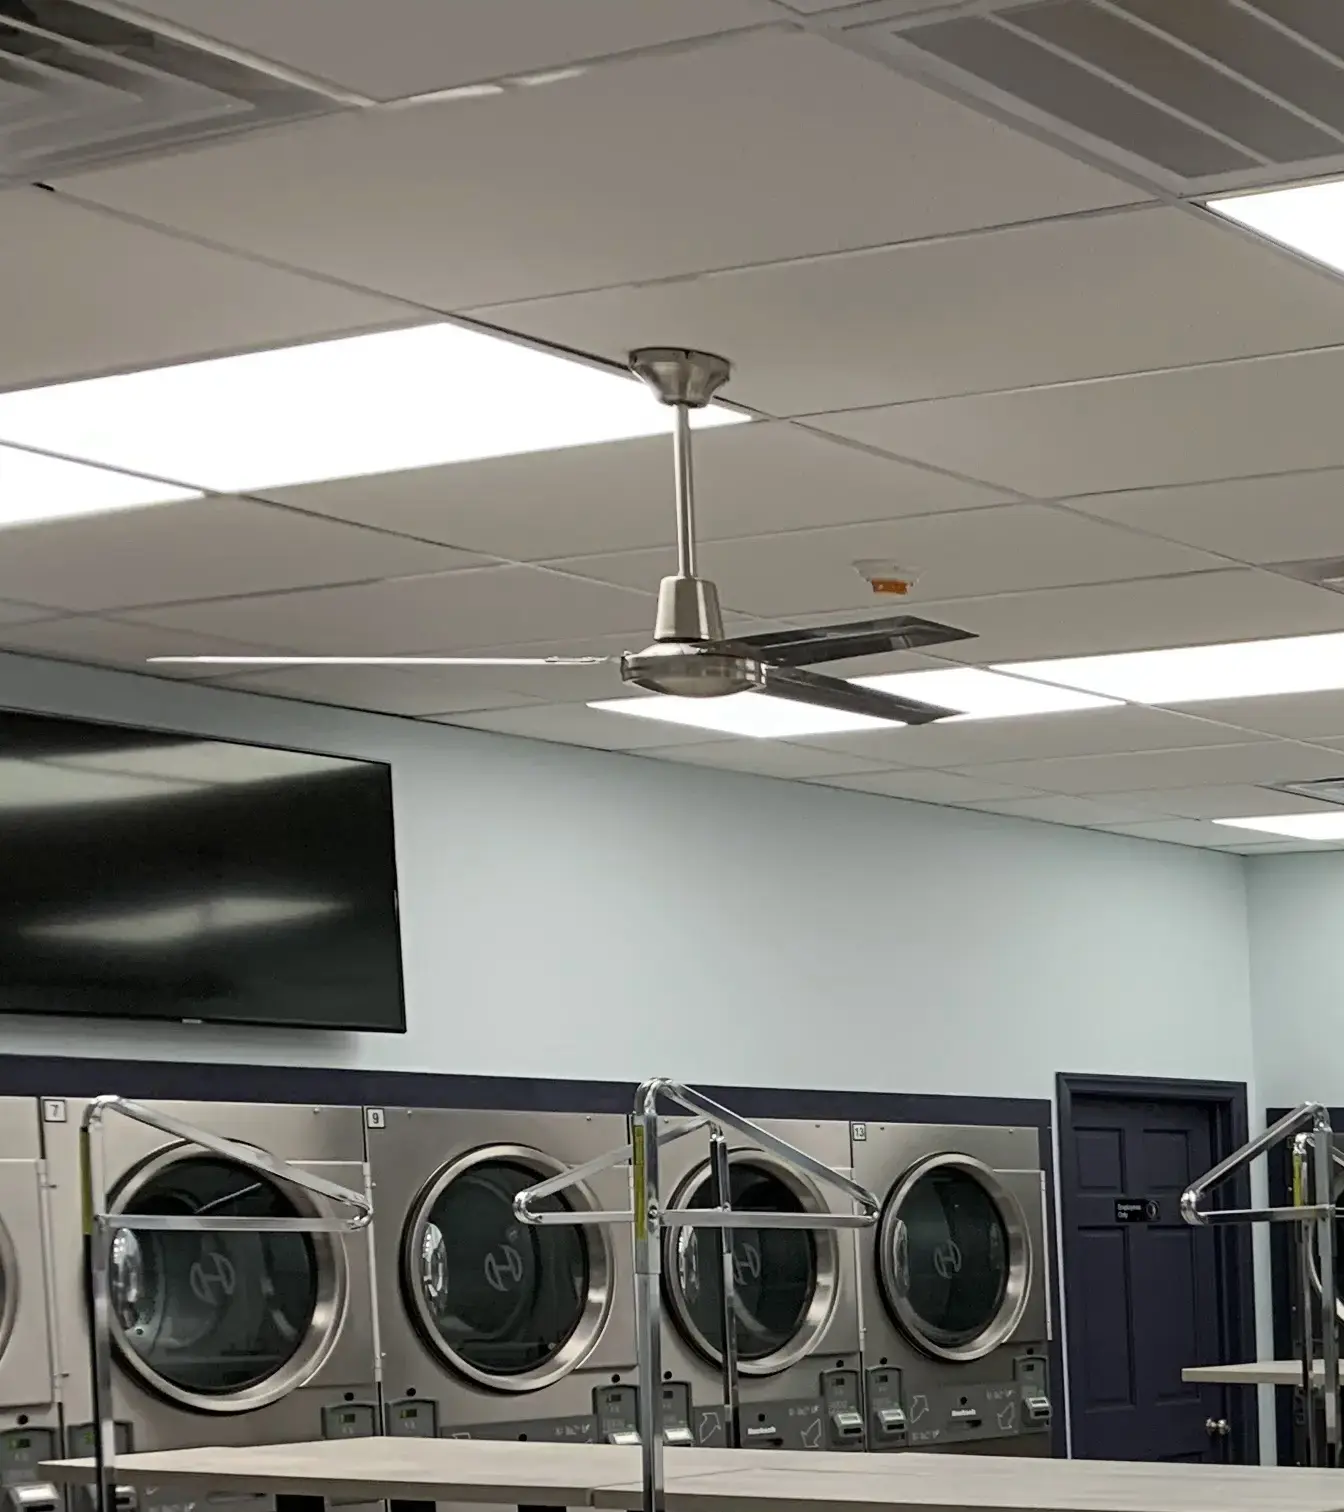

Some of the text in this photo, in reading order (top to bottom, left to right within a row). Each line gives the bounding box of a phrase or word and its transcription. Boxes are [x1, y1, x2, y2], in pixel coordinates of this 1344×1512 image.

[49, 1104, 59, 1118] 7
[371, 1112, 379, 1124] 9
[854, 1127, 864, 1137] 13
